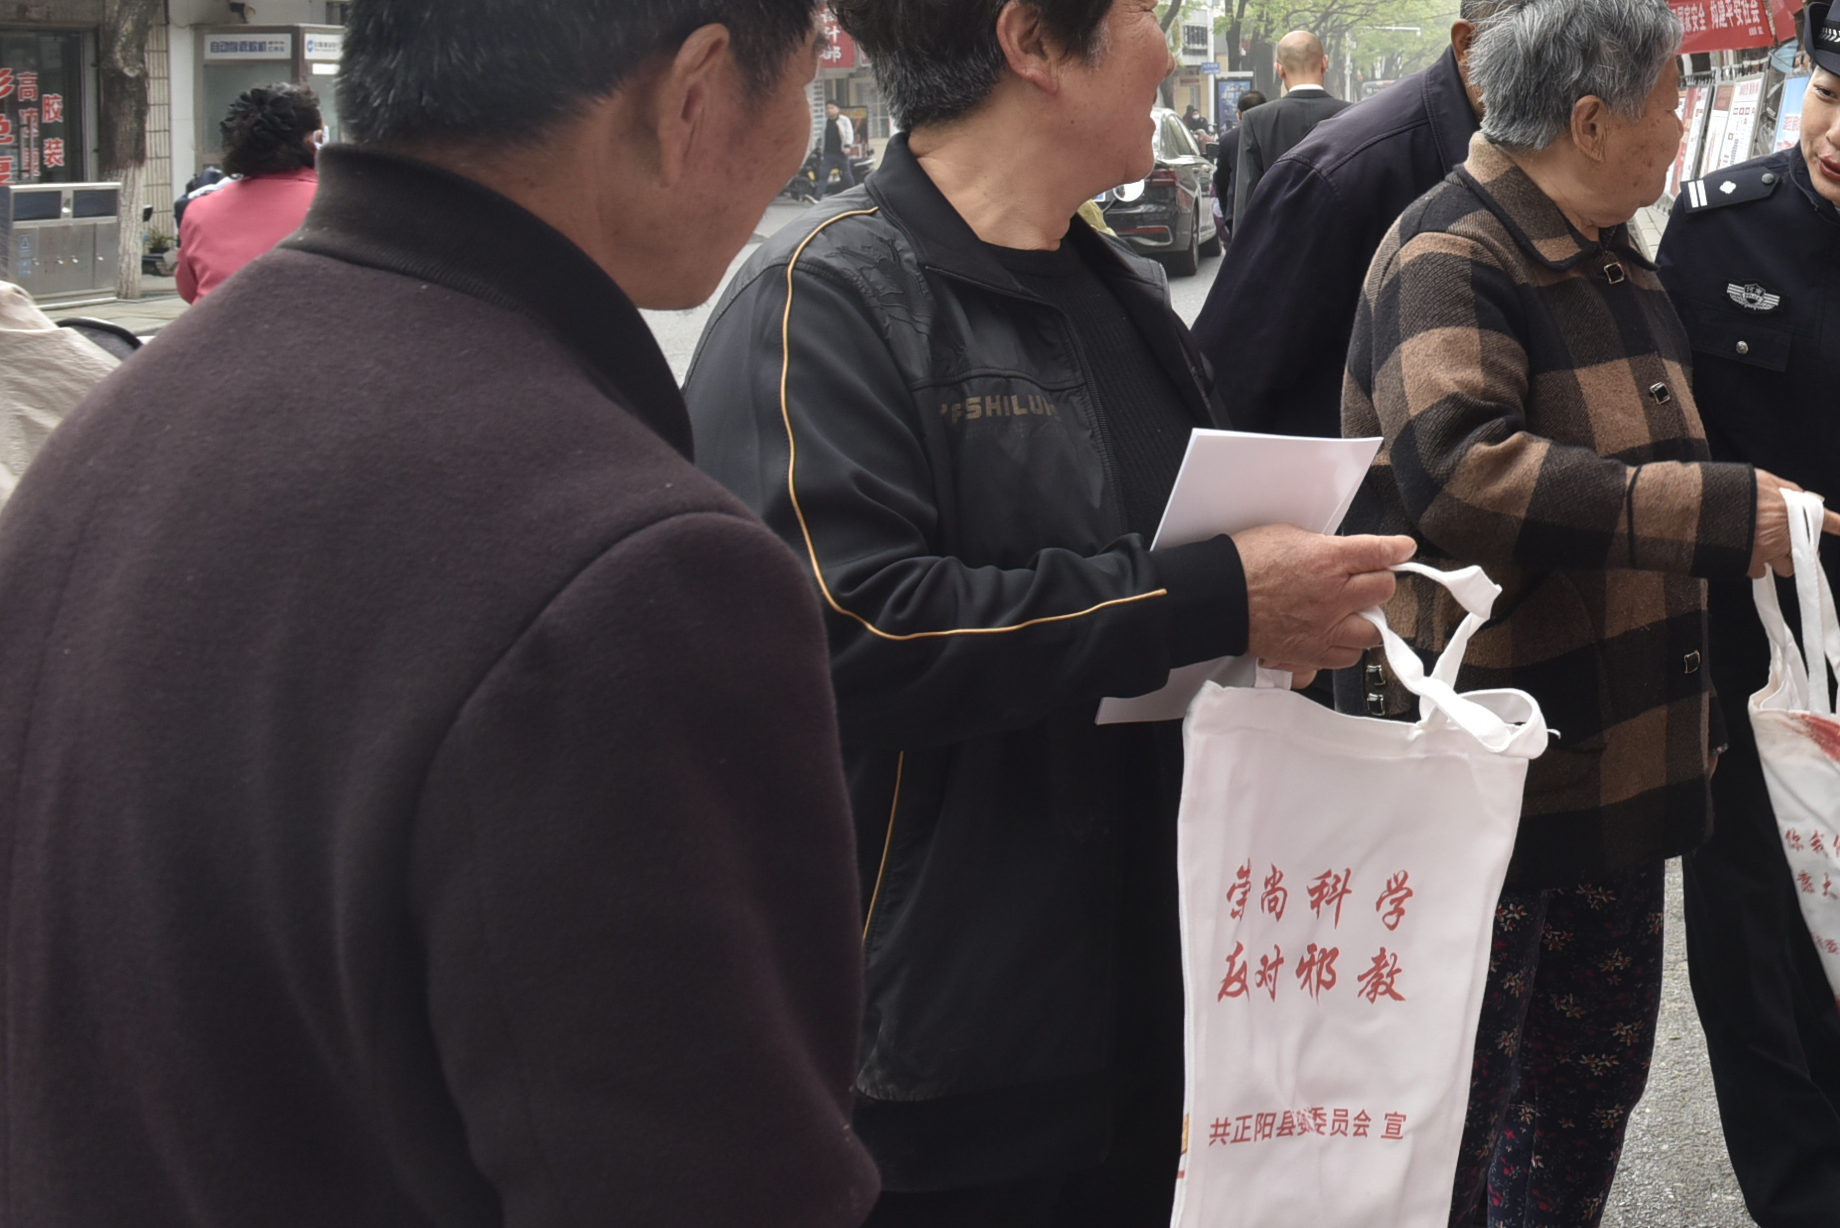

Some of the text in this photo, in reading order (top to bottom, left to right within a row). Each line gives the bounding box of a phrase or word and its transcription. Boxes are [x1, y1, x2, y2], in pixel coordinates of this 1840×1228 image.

[42, 93, 65, 167] 胶装
[1217, 940, 1407, 1006] 反对邪教
[1380, 1111, 1408, 1141] 宣
